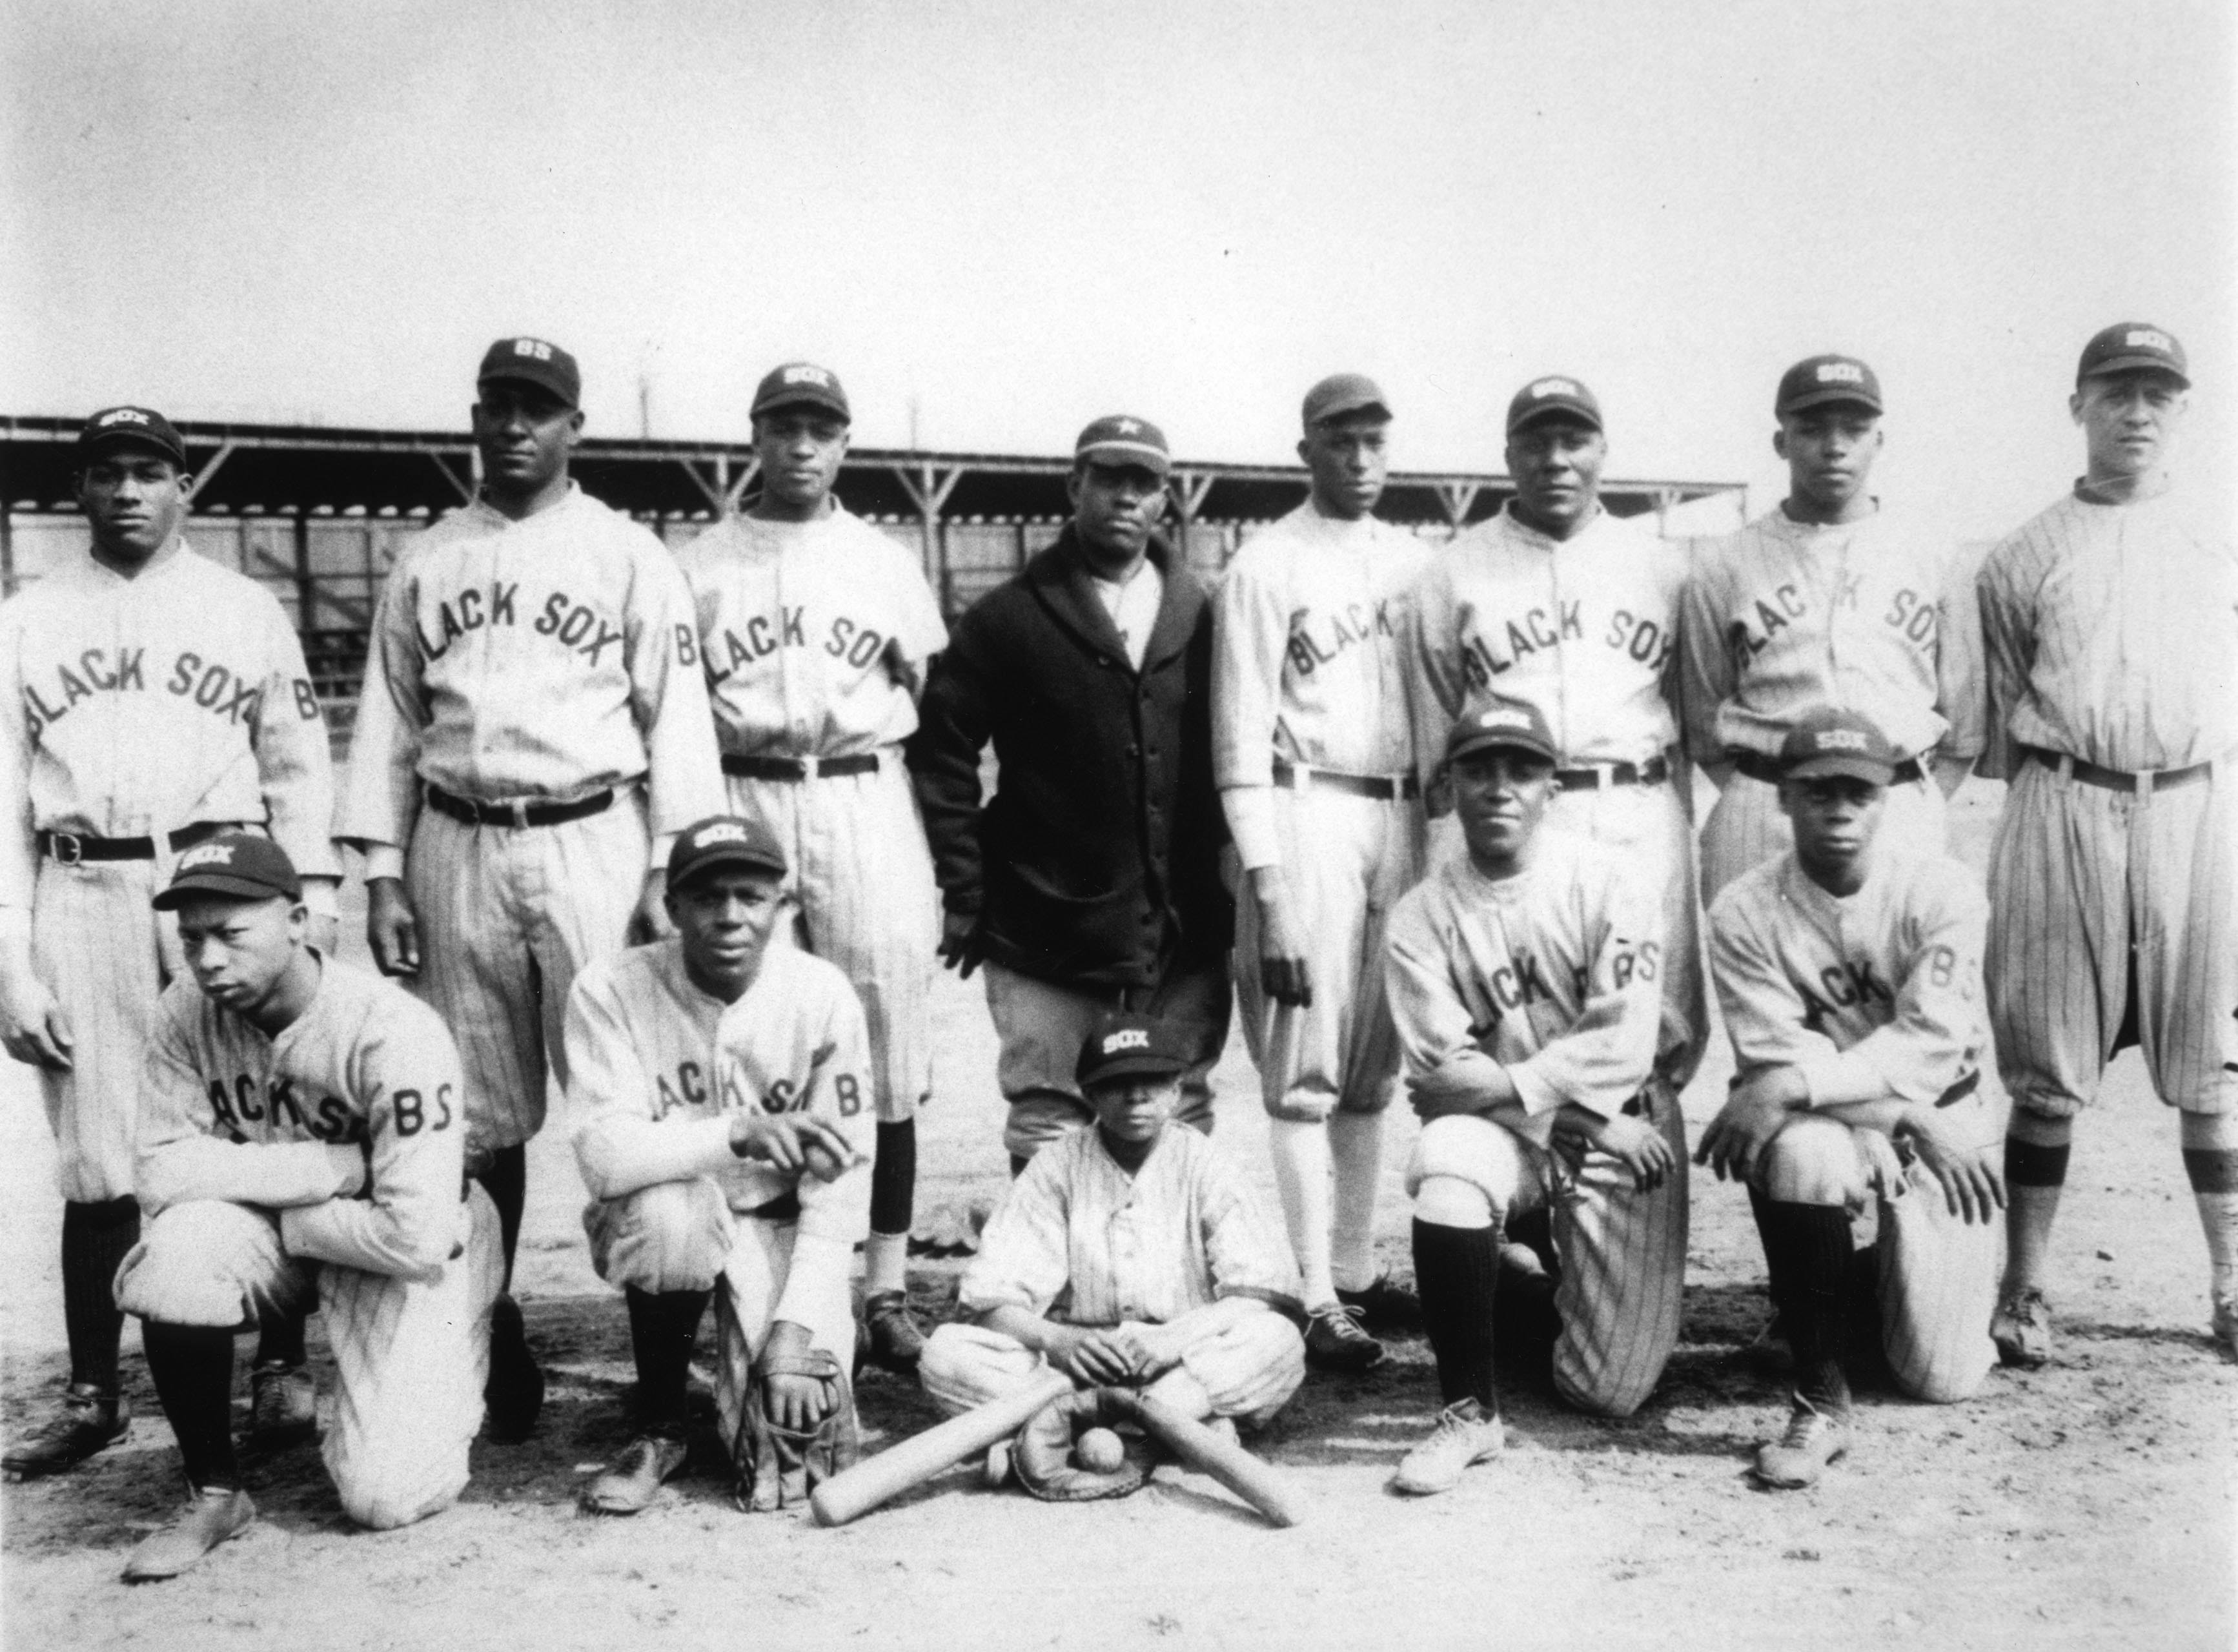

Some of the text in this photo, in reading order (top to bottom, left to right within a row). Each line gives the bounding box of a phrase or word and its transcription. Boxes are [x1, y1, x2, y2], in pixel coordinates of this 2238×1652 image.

[514, 339, 552, 362] BS
[1816, 363, 1864, 383] SOX
[784, 368, 829, 387] SOX
[417, 581, 623, 668] LACK SOX
[825, 617, 883, 669] SO
[167, 651, 259, 725] SOX
[180, 844, 236, 870] SOX
[1796, 960, 1891, 1031] ACK
[1103, 1028, 1150, 1054] SOX
[210, 1074, 299, 1128] ACK
[392, 1082, 452, 1137] BS
[653, 1061, 745, 1122] ACK
